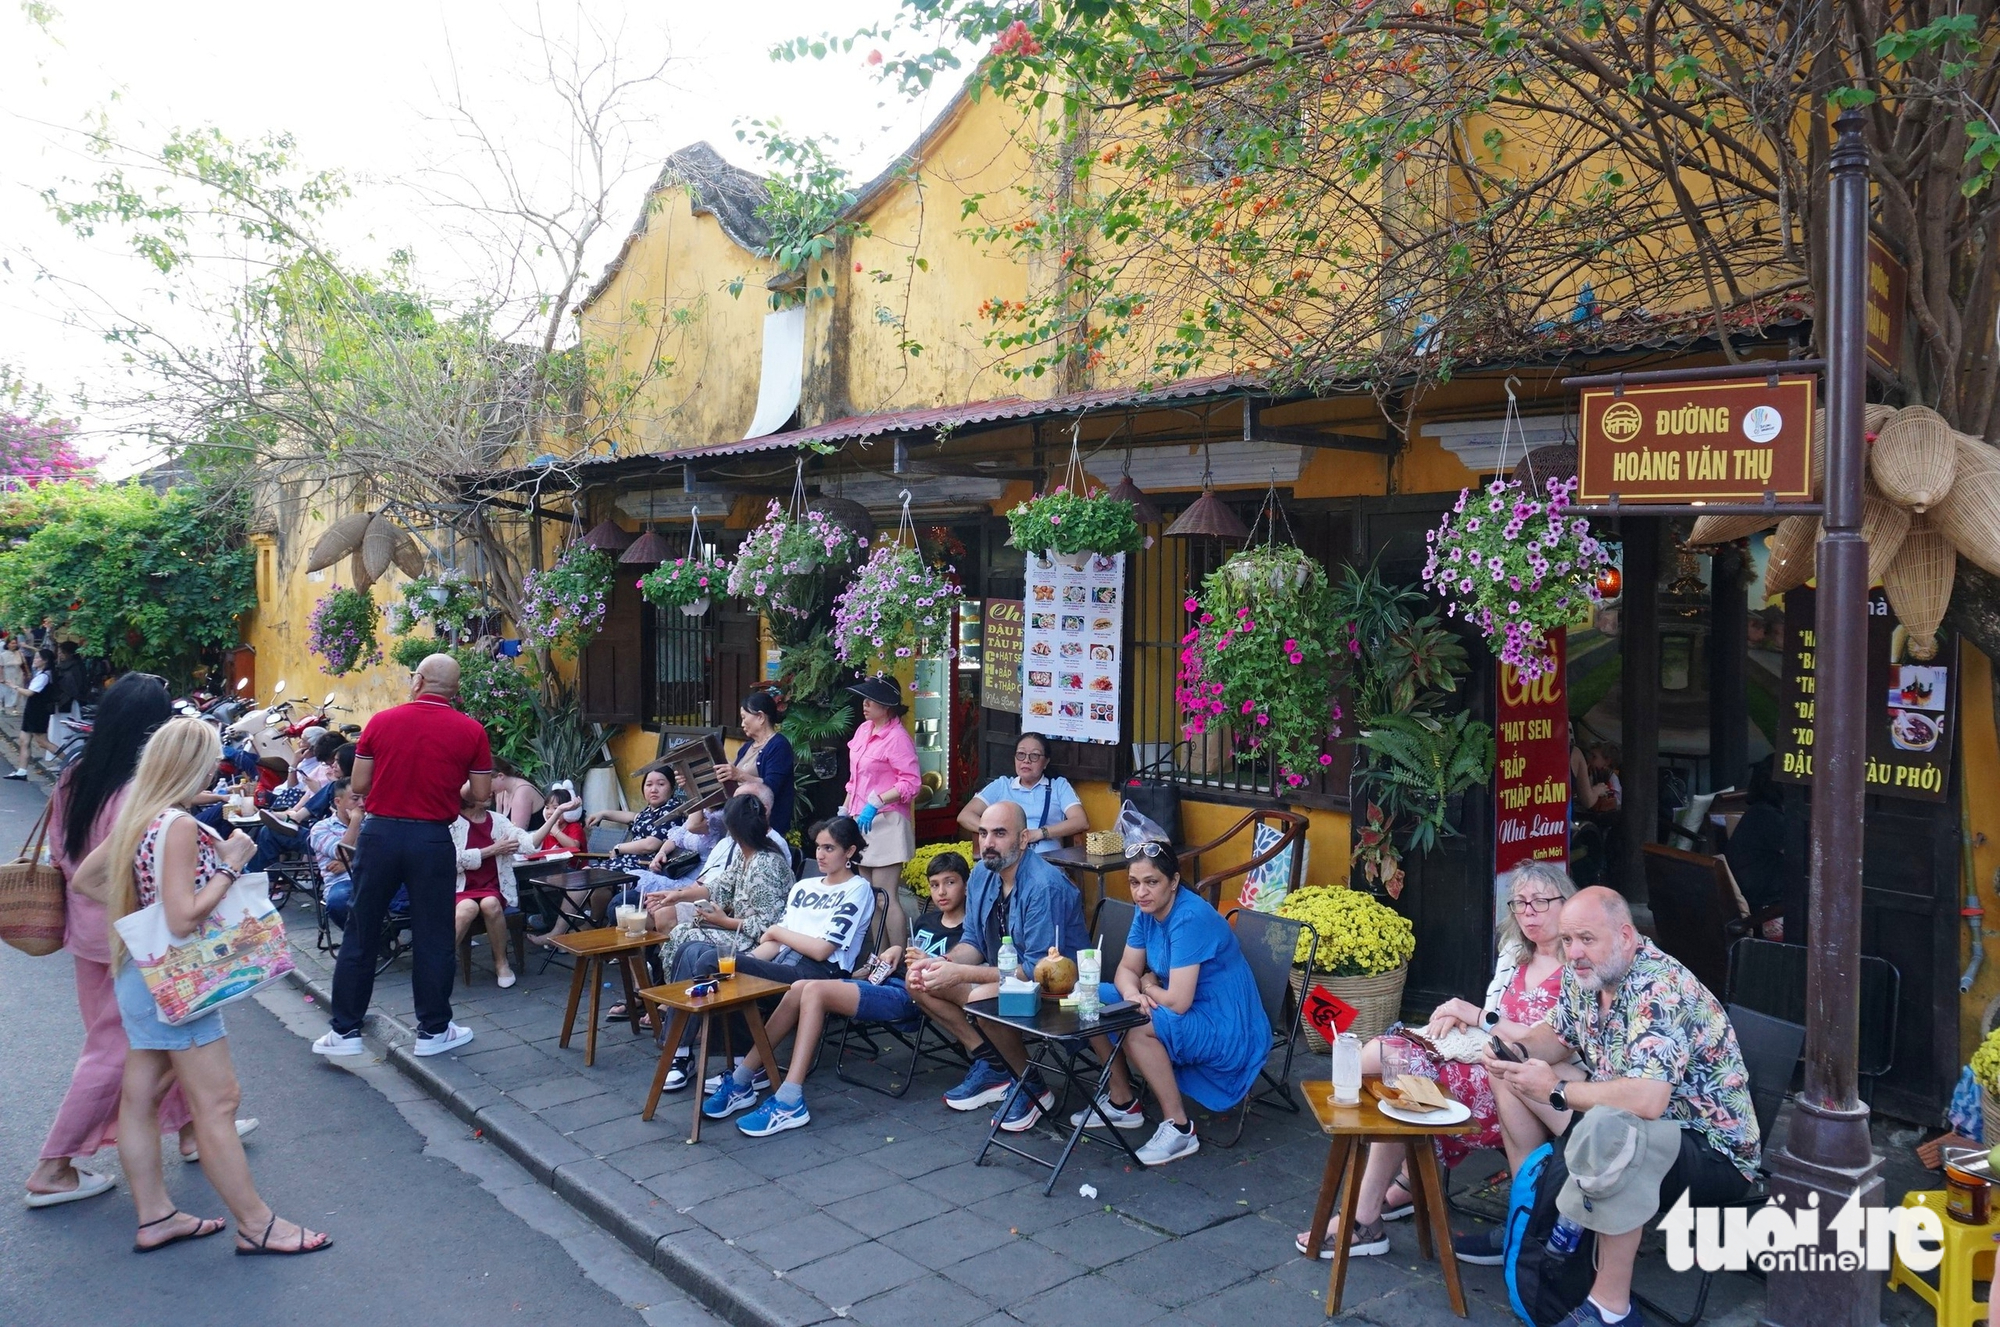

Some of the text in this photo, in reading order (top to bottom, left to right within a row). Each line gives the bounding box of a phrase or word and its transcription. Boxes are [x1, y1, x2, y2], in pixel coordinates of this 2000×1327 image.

[1656, 402, 1729, 436] ĐƯỜNG
[1613, 445, 1773, 485] HOÀNG VĂN THỤ
[989, 603, 1023, 621] Ch
[987, 623, 1014, 637] ĐẬU
[987, 636, 1010, 649] TÀU
[999, 650, 1013, 664] HẠT
[998, 664, 1012, 679] BẮP
[998, 680, 1016, 695] THẬP
[1504, 719, 1552, 747] HẠT SEN
[1504, 750, 1527, 780] BẮP
[1504, 775, 1567, 812] THẬP CẨM
[1498, 813, 1566, 845] Nhà Làm
